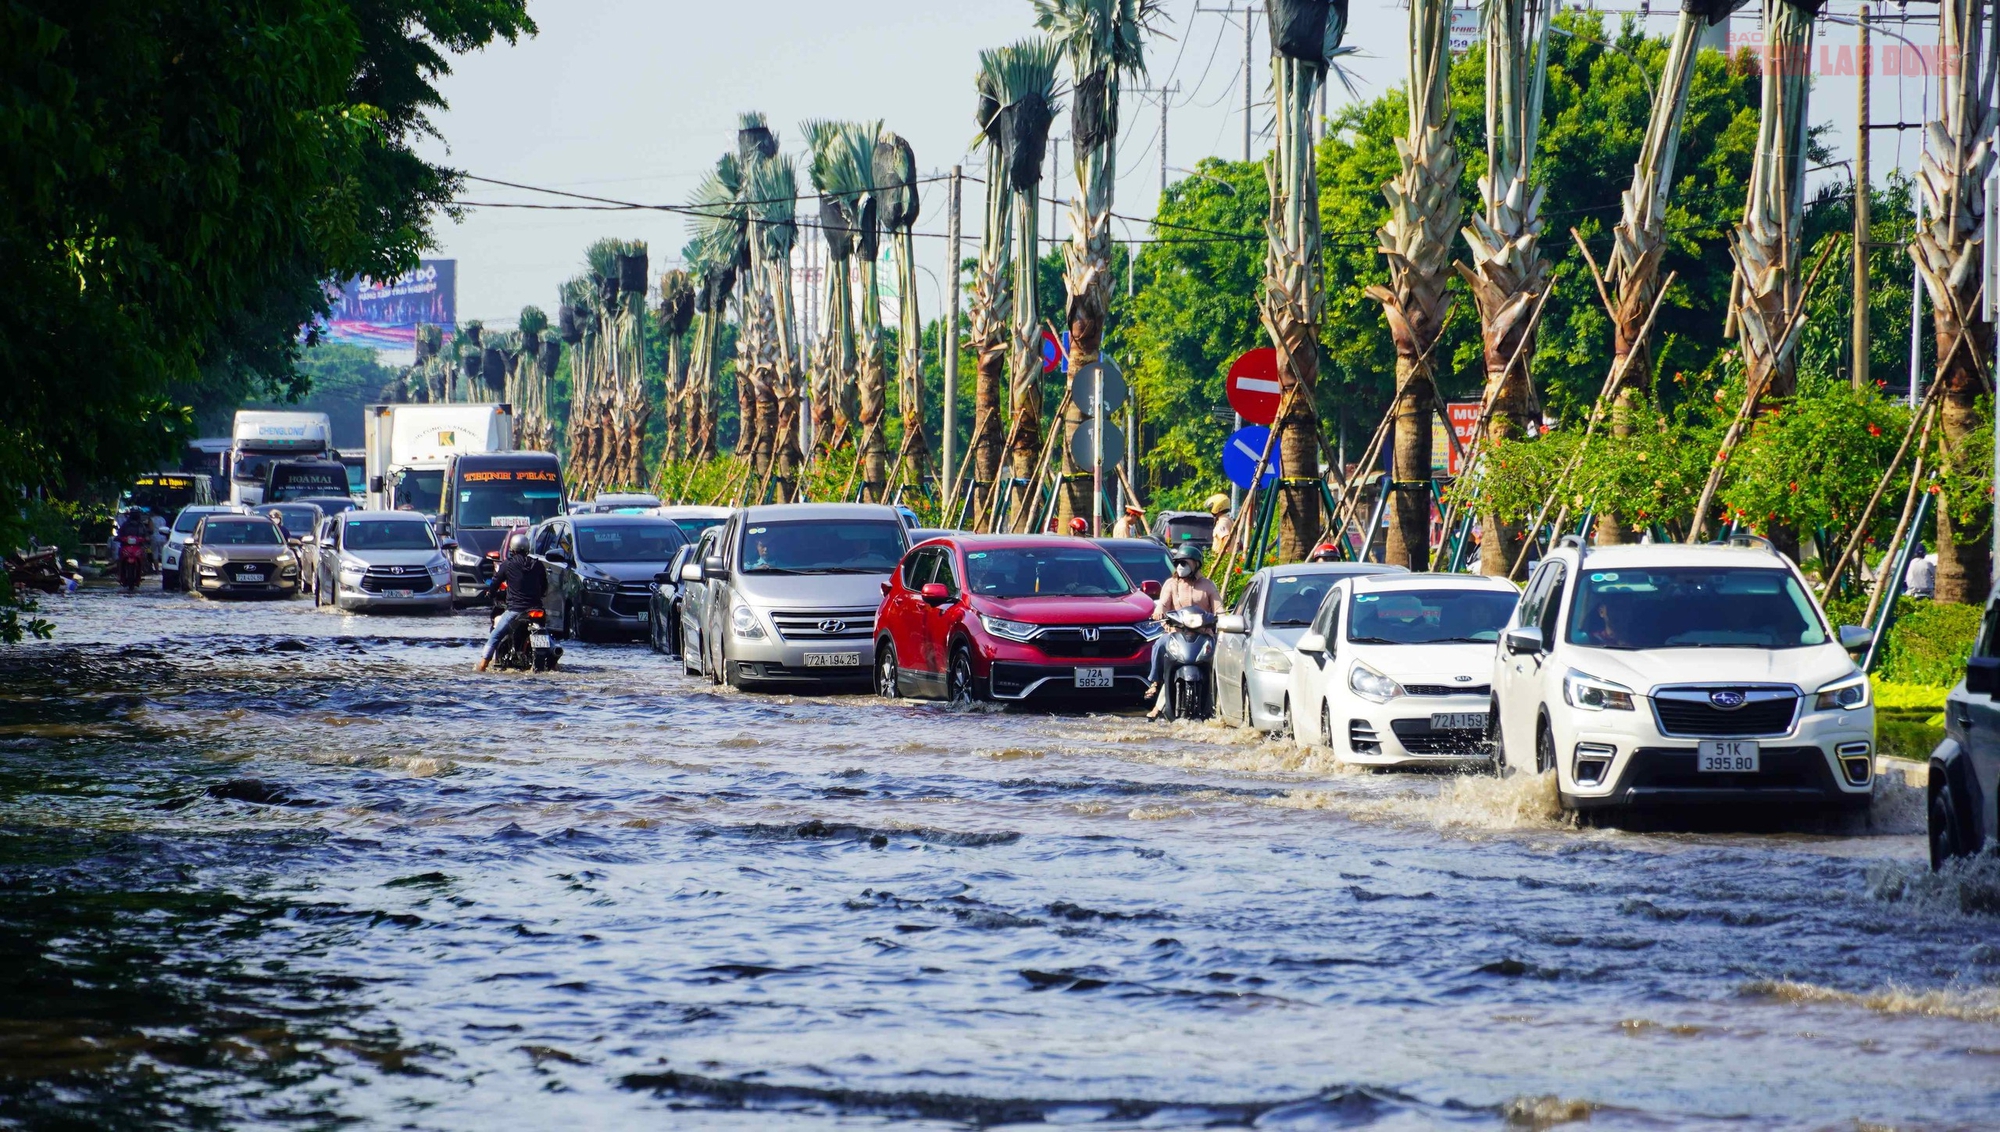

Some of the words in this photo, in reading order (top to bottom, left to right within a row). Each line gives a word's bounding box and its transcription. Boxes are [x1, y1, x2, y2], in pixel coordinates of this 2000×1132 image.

[259, 426, 304, 436] CHENGLONG
[464, 471, 511, 482] THỊNH
[516, 470, 556, 481] PHÁT
[808, 654, 858, 666] 72A-194.25
[1087, 669, 1103, 677] 72A
[1079, 678, 1110, 687] 585.22
[1716, 743, 1741, 755] 51K
[1705, 757, 1753, 770] 395.80
